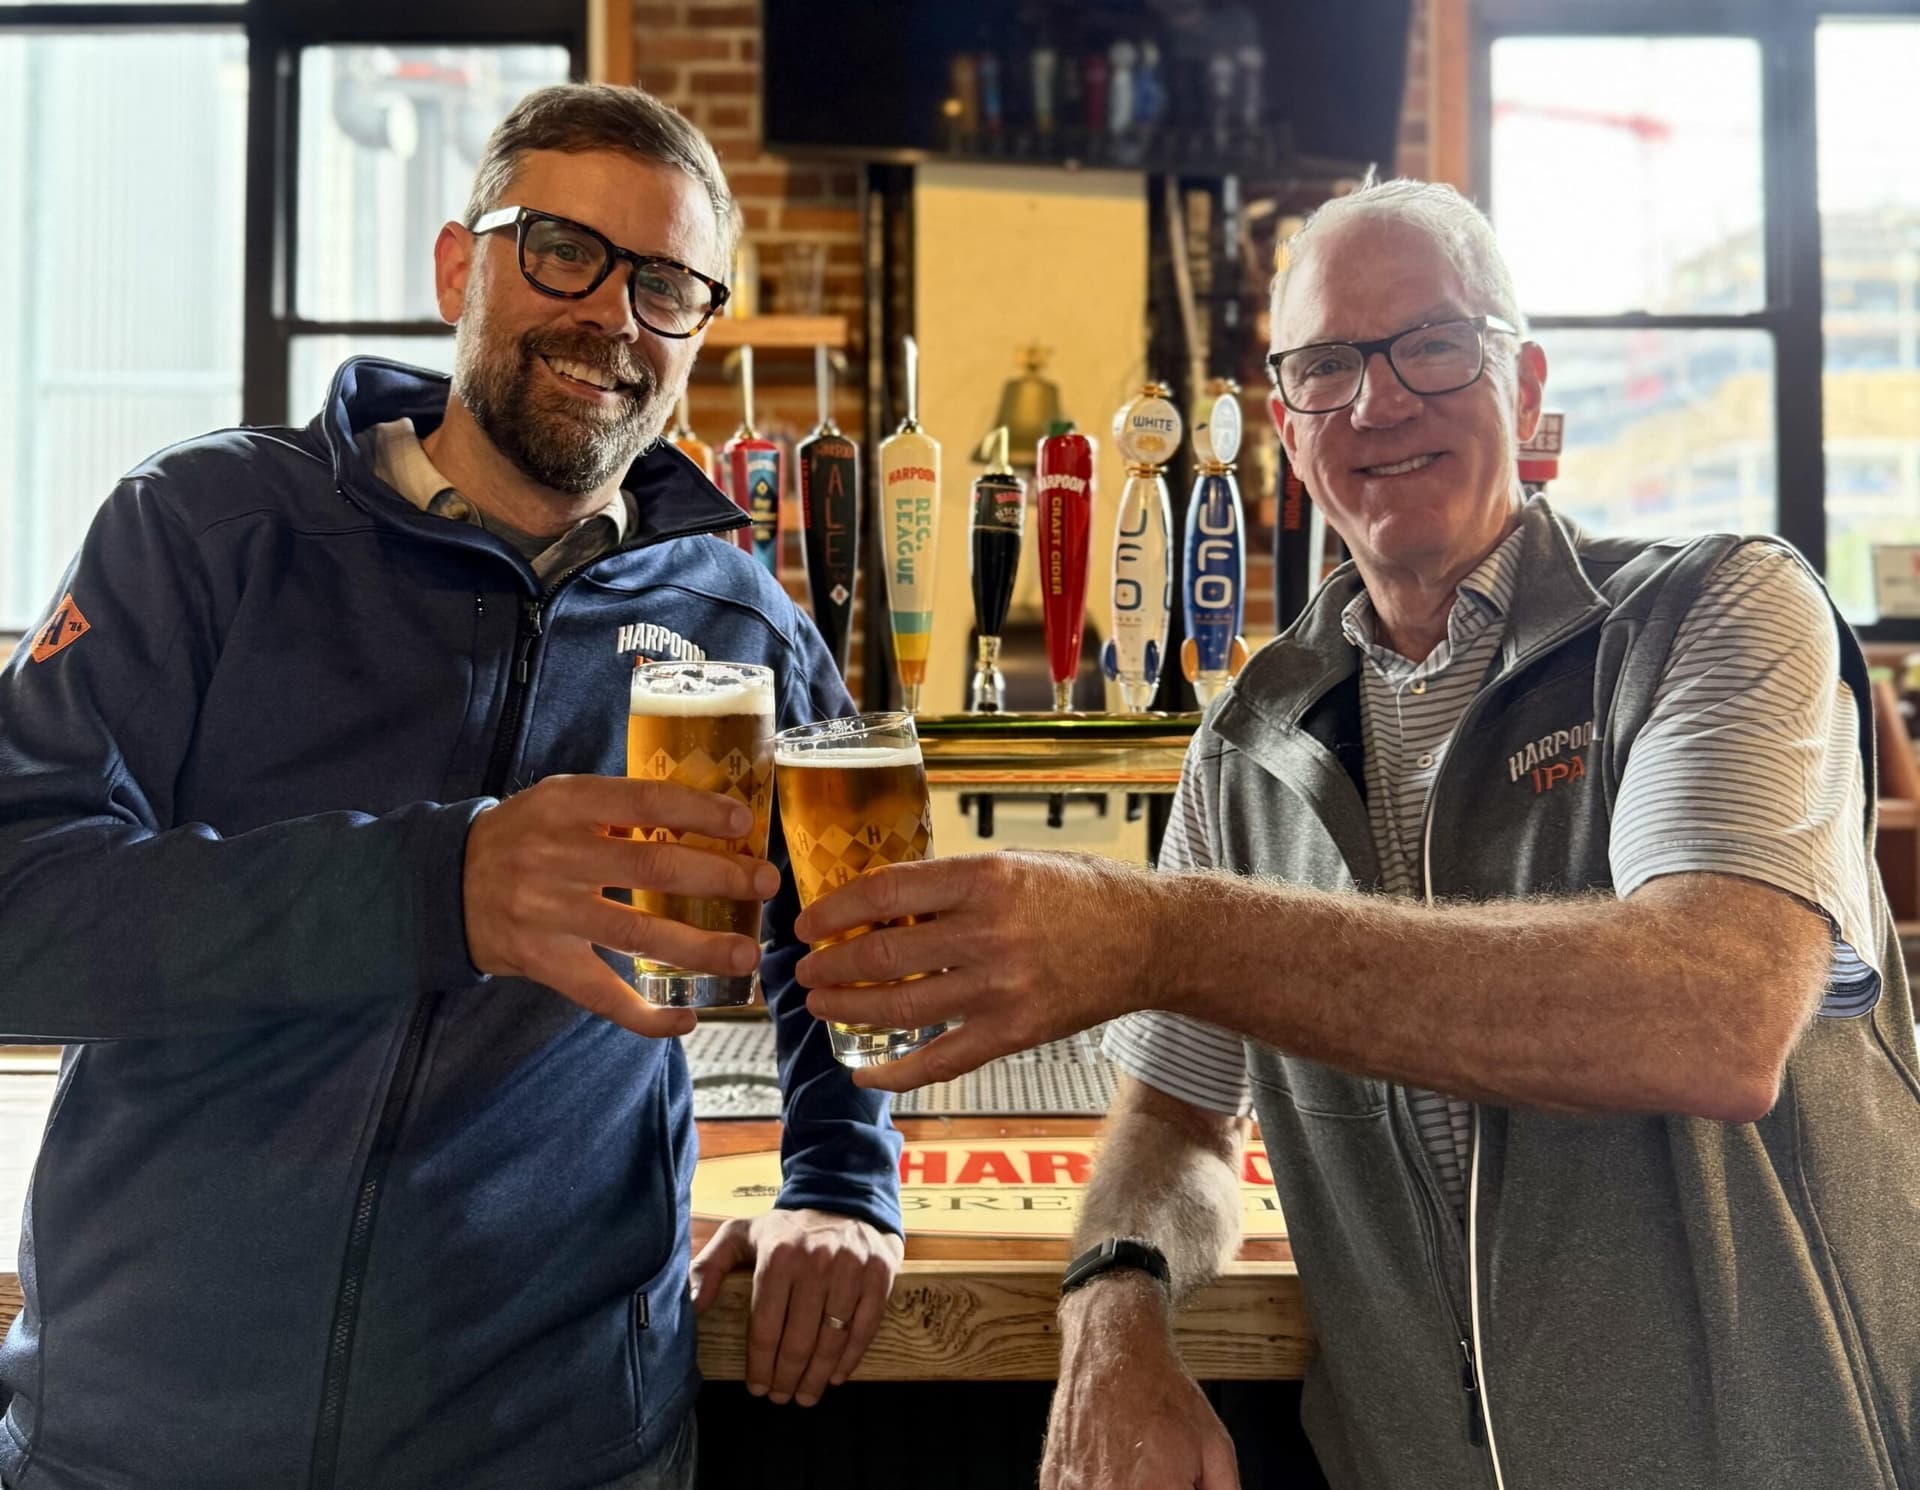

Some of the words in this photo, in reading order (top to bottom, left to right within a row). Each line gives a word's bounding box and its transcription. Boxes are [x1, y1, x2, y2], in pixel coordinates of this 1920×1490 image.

[1133, 415, 1173, 432] WHITE
[887, 466, 936, 486] HARPOON
[896, 497, 914, 585] LEAGUE
[915, 497, 931, 552] REC.
[1051, 496, 1062, 546] CRAFT
[1051, 550, 1062, 596] CIDER
[1508, 720, 1592, 783] HARPOO
[1531, 755, 1586, 794] IPA
